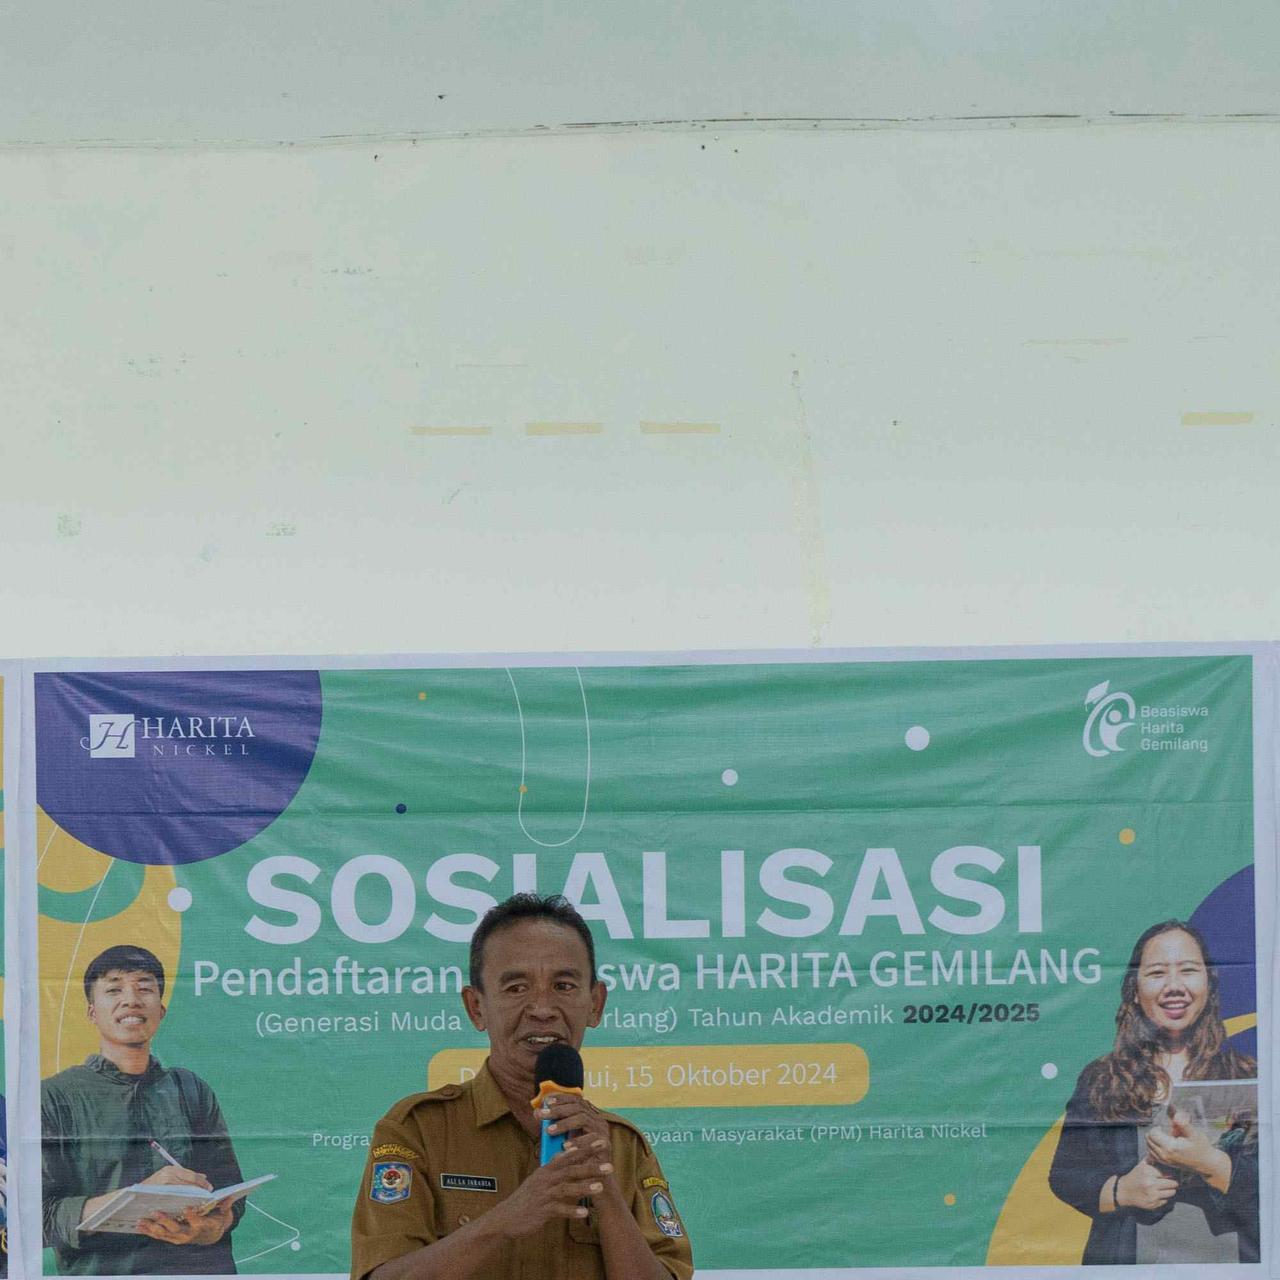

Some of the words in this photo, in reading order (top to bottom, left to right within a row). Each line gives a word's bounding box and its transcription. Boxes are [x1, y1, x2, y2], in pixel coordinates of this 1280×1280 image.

[1141, 705, 1208, 718] Beasiswa
[142, 716, 256, 740] HARITA
[1141, 721, 1184, 734] Harita
[153, 743, 250, 757] NICKEL
[1141, 737, 1208, 752] Gemilang
[194, 956, 463, 997] Pendaftaran
[696, 952, 858, 989] HARITA
[869, 947, 1102, 986] GEMILANG
[256, 1010, 380, 1038] (Generasi
[391, 1009, 462, 1032] Muda
[600, 1006, 678, 1034] rlang)
[688, 1007, 762, 1027] Tahun
[771, 1004, 894, 1026] Akademik
[903, 1002, 1041, 1025] 2024/2025
[626, 1066, 654, 1087] 15
[667, 1063, 770, 1087] Oktober
[777, 1063, 839, 1086] 2024
[312, 1133, 371, 1150] Progra
[702, 1126, 804, 1146] Masyarakat
[810, 1125, 863, 1143] (PPM)
[870, 1125, 924, 1140] Harita
[931, 1123, 987, 1138] Nickel
